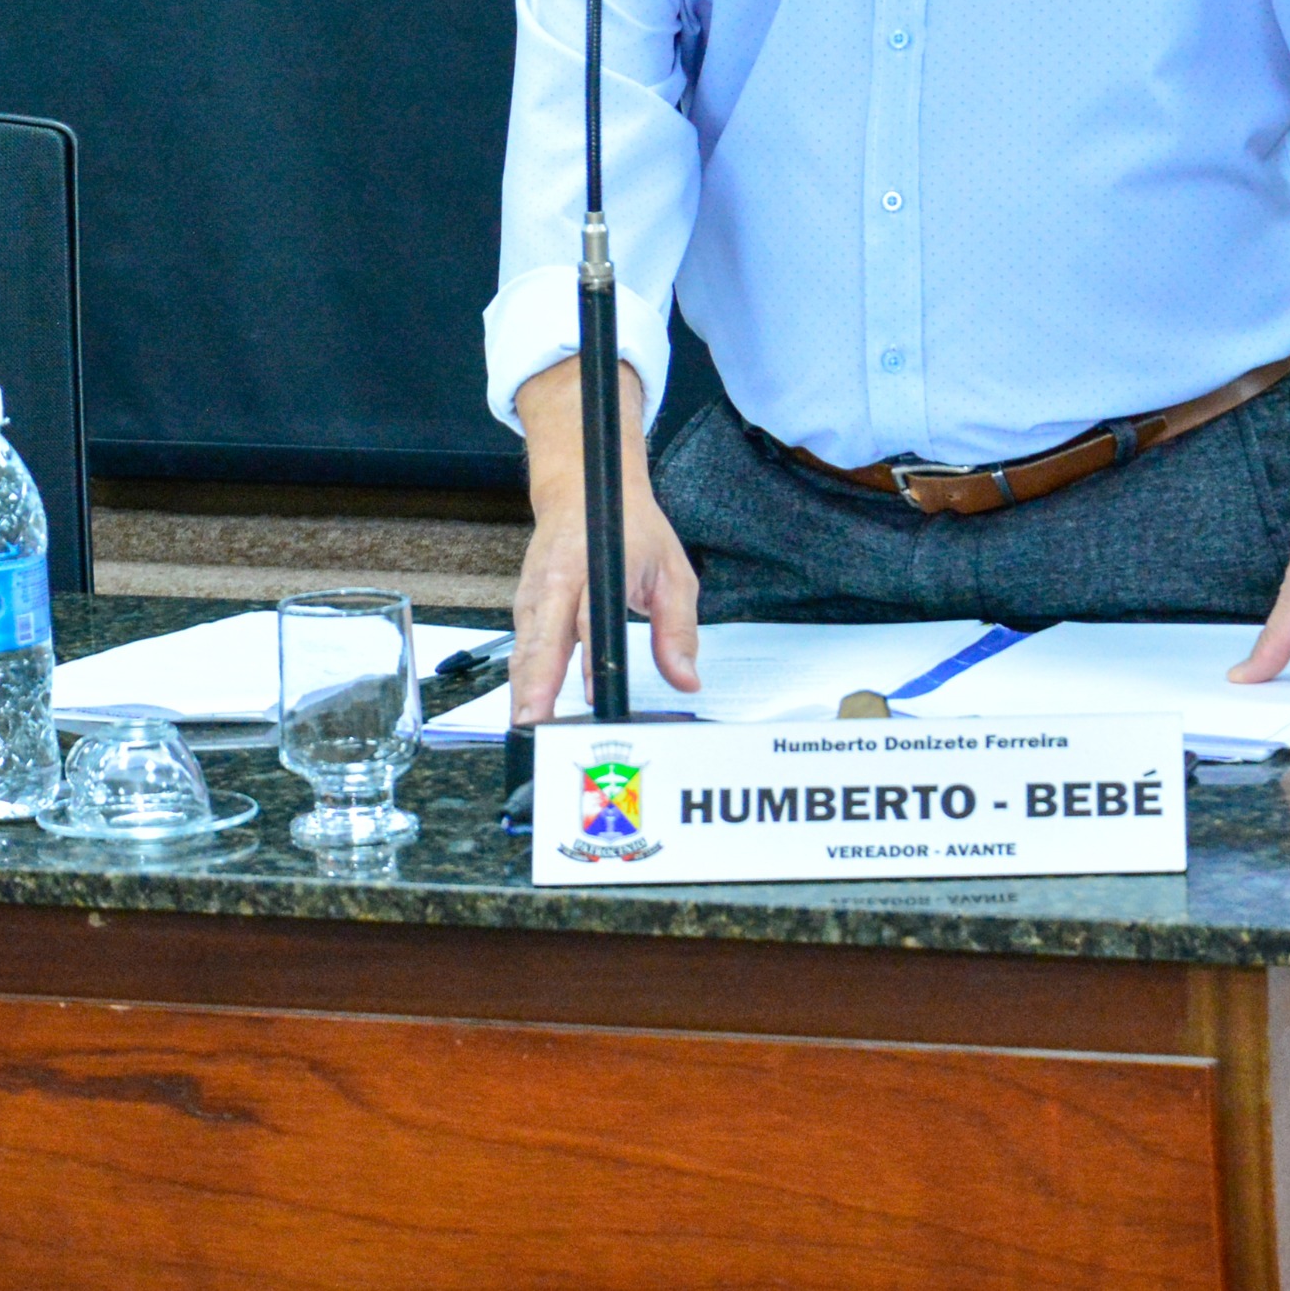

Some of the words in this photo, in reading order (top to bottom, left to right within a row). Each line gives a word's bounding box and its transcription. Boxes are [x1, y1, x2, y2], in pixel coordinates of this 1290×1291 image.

[773, 737, 878, 753] Humberto
[884, 735, 978, 751] Donizete
[985, 733, 1069, 750] Ferreira
[680, 783, 977, 825] HUMBERTO
[1025, 769, 1163, 819] BEBÉ
[826, 844, 929, 859] VEREADOR
[945, 843, 1017, 857] AVANTE
